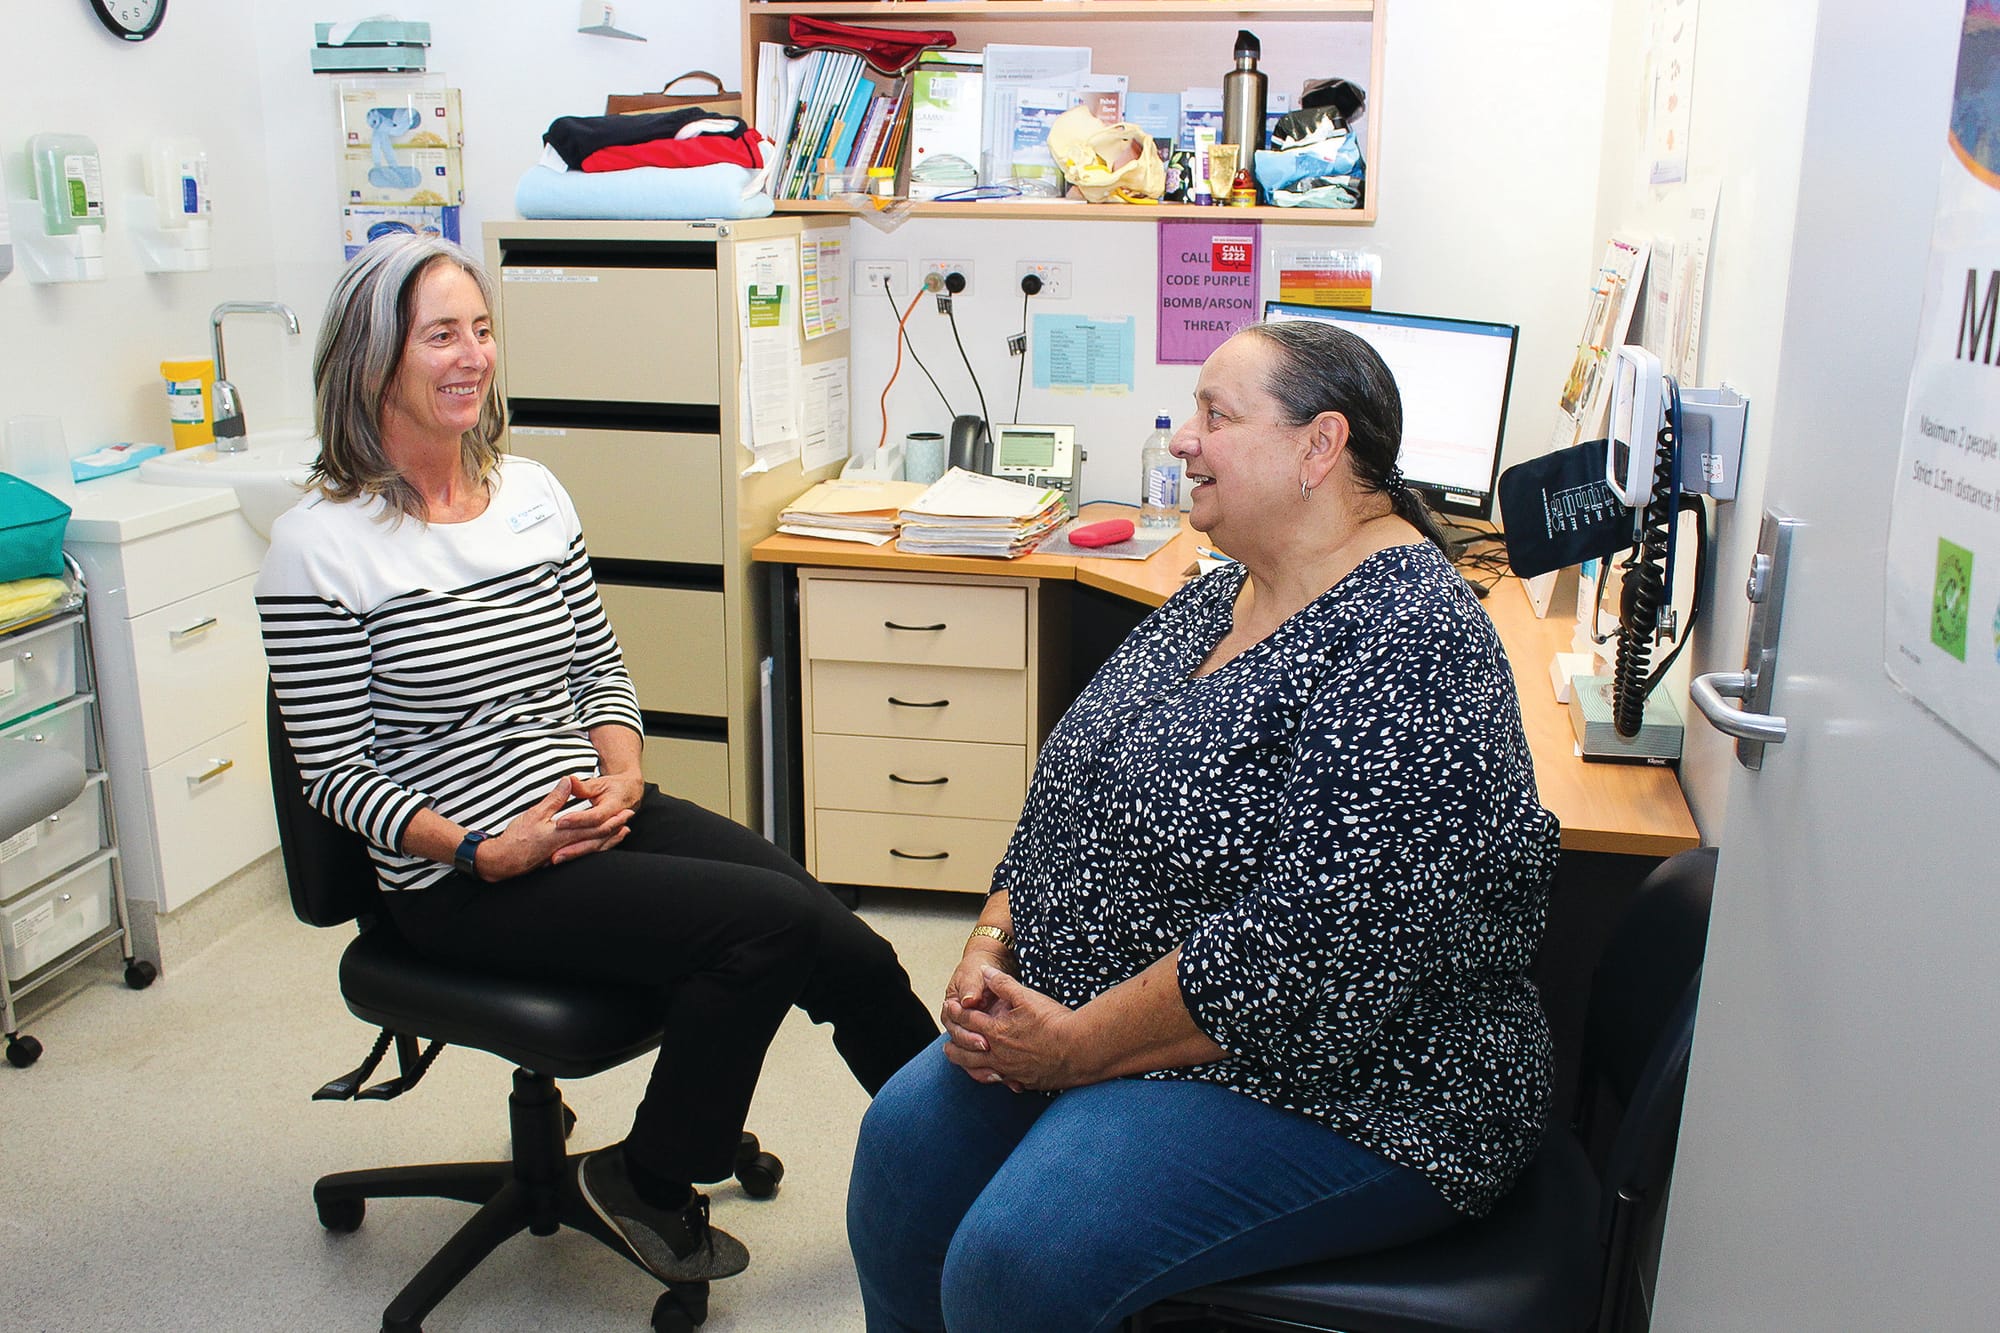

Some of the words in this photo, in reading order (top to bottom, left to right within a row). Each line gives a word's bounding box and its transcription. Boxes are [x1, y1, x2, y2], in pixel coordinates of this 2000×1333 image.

[109, 2, 115, 11] 7
[134, 7, 141, 18] 5
[122, 10, 128, 20] 6
[346, 230, 352, 242] S
[1181, 252, 1210, 263] CALL
[1222, 253, 1246, 261] 2222
[1166, 274, 1200, 286] CODE
[1204, 276, 1251, 286] PURPLE
[1163, 297, 1252, 310] BOMB/ARSON
[1184, 320, 1232, 332] THREAT
[1920, 414, 1956, 446] Maximum
[1958, 426, 1966, 448] 2
[1965, 434, 1998, 462] people
[1148, 468, 1166, 509] pump
[1912, 460, 1934, 486] Strict
[1934, 468, 1953, 495] 1.5m
[1954, 477, 1992, 509] distance
